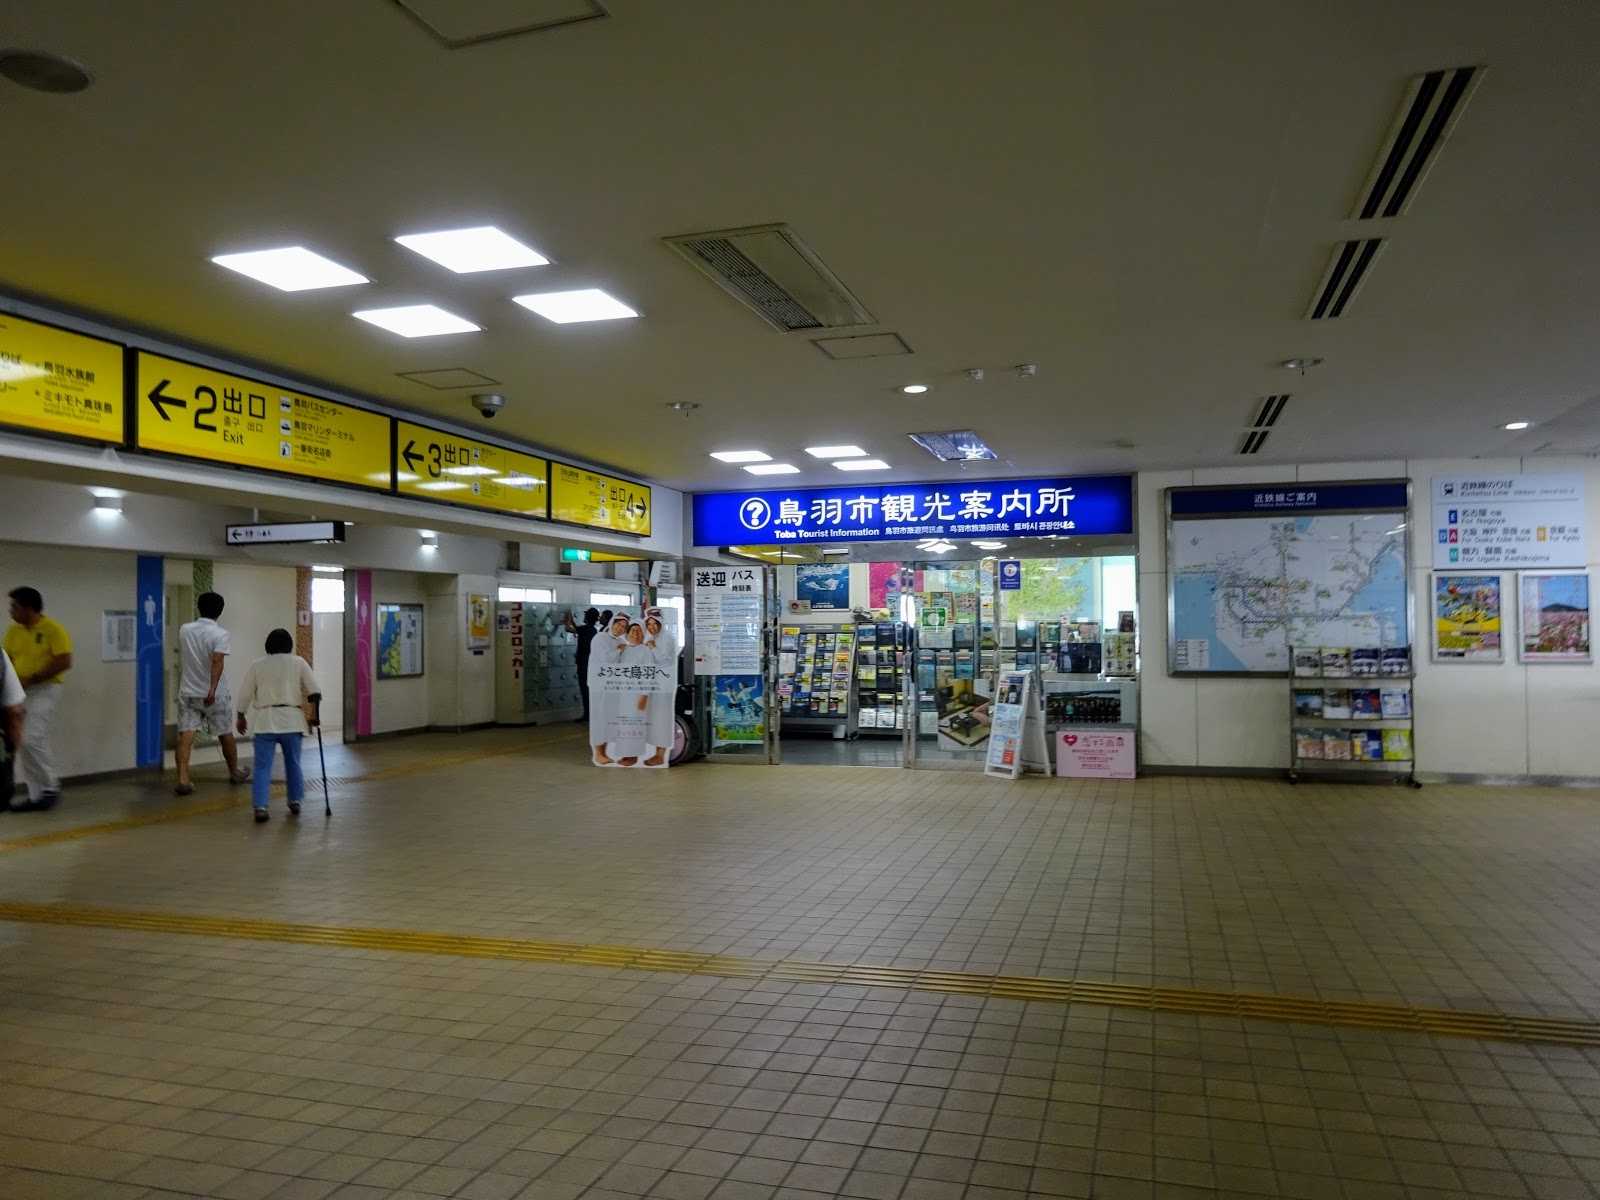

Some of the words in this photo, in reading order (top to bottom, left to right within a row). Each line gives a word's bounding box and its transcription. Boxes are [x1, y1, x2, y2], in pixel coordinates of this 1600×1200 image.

[194, 384, 217, 432] 2
[223, 387, 266, 420] 出口
[223, 430, 244, 445] Exit
[428, 443, 442, 478] 3
[444, 444, 470, 466] 出口
[610, 487, 625, 503] 出口
[626, 493, 635, 518] 4
[773, 486, 1076, 527] 鳥羽市観光案内所
[1254, 492, 1317, 503] 近鉄線ご案内
[774, 530, 797, 539] Toba
[798, 529, 829, 538] Tourist
[830, 527, 880, 537] Information
[696, 571, 727, 587] 送迎
[732, 570, 754, 580] バス
[511, 602, 523, 679] コインロッカー
